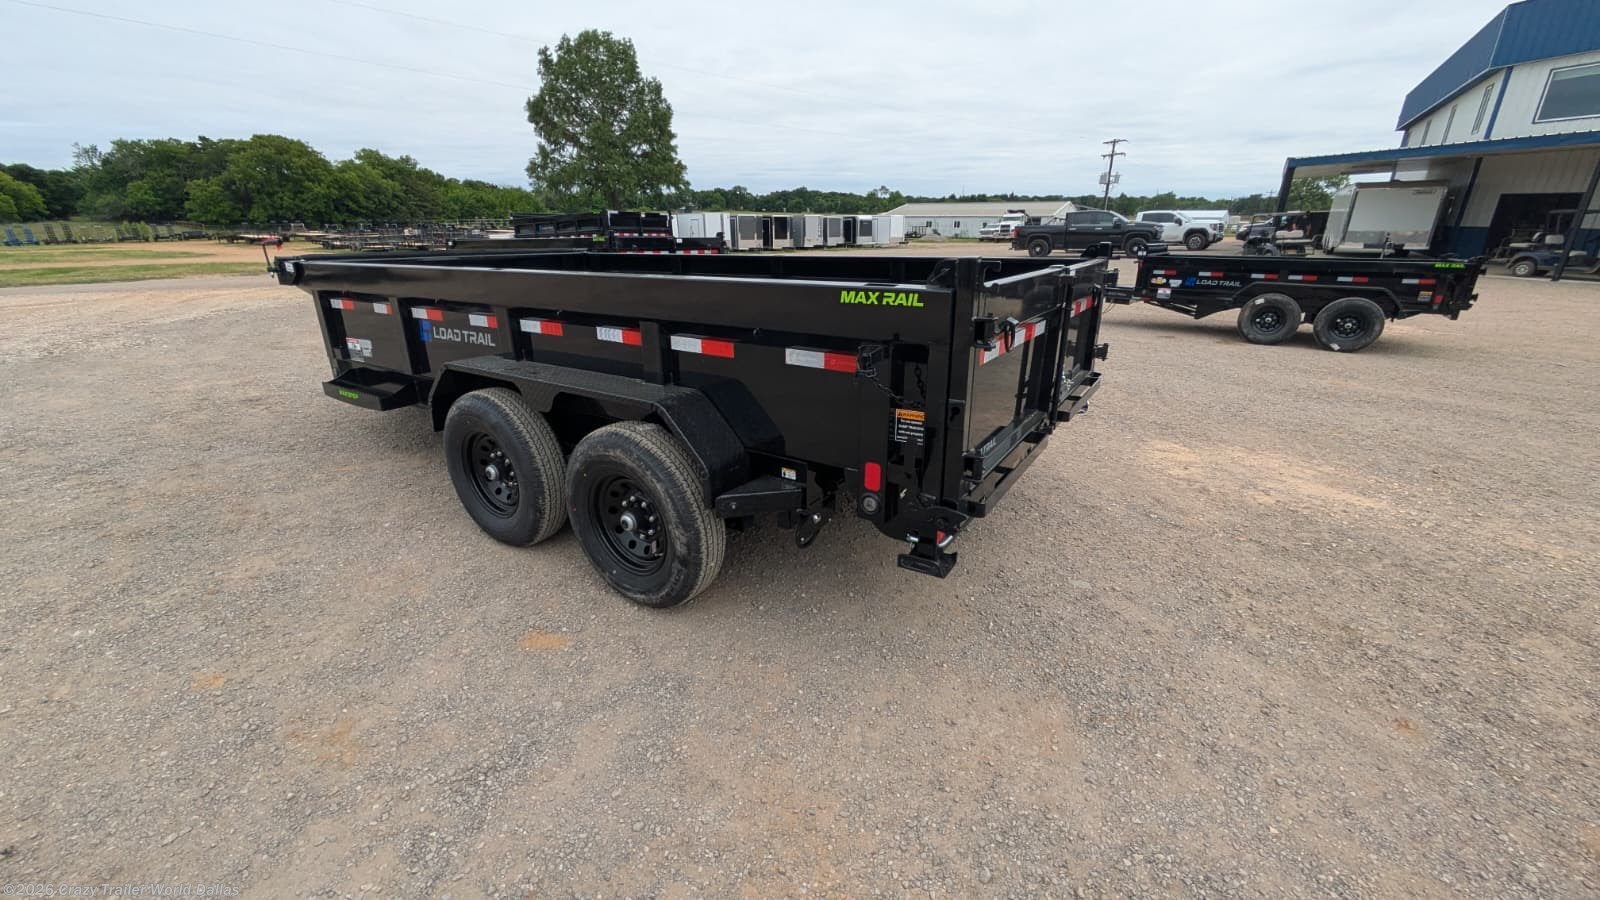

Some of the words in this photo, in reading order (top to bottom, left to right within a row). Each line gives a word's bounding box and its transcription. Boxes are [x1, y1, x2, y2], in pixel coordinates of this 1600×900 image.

[840, 290, 879, 304] MAX
[882, 292, 924, 307] RAIL
[432, 326, 461, 341] LOAD
[461, 330, 496, 346] TRAIL
